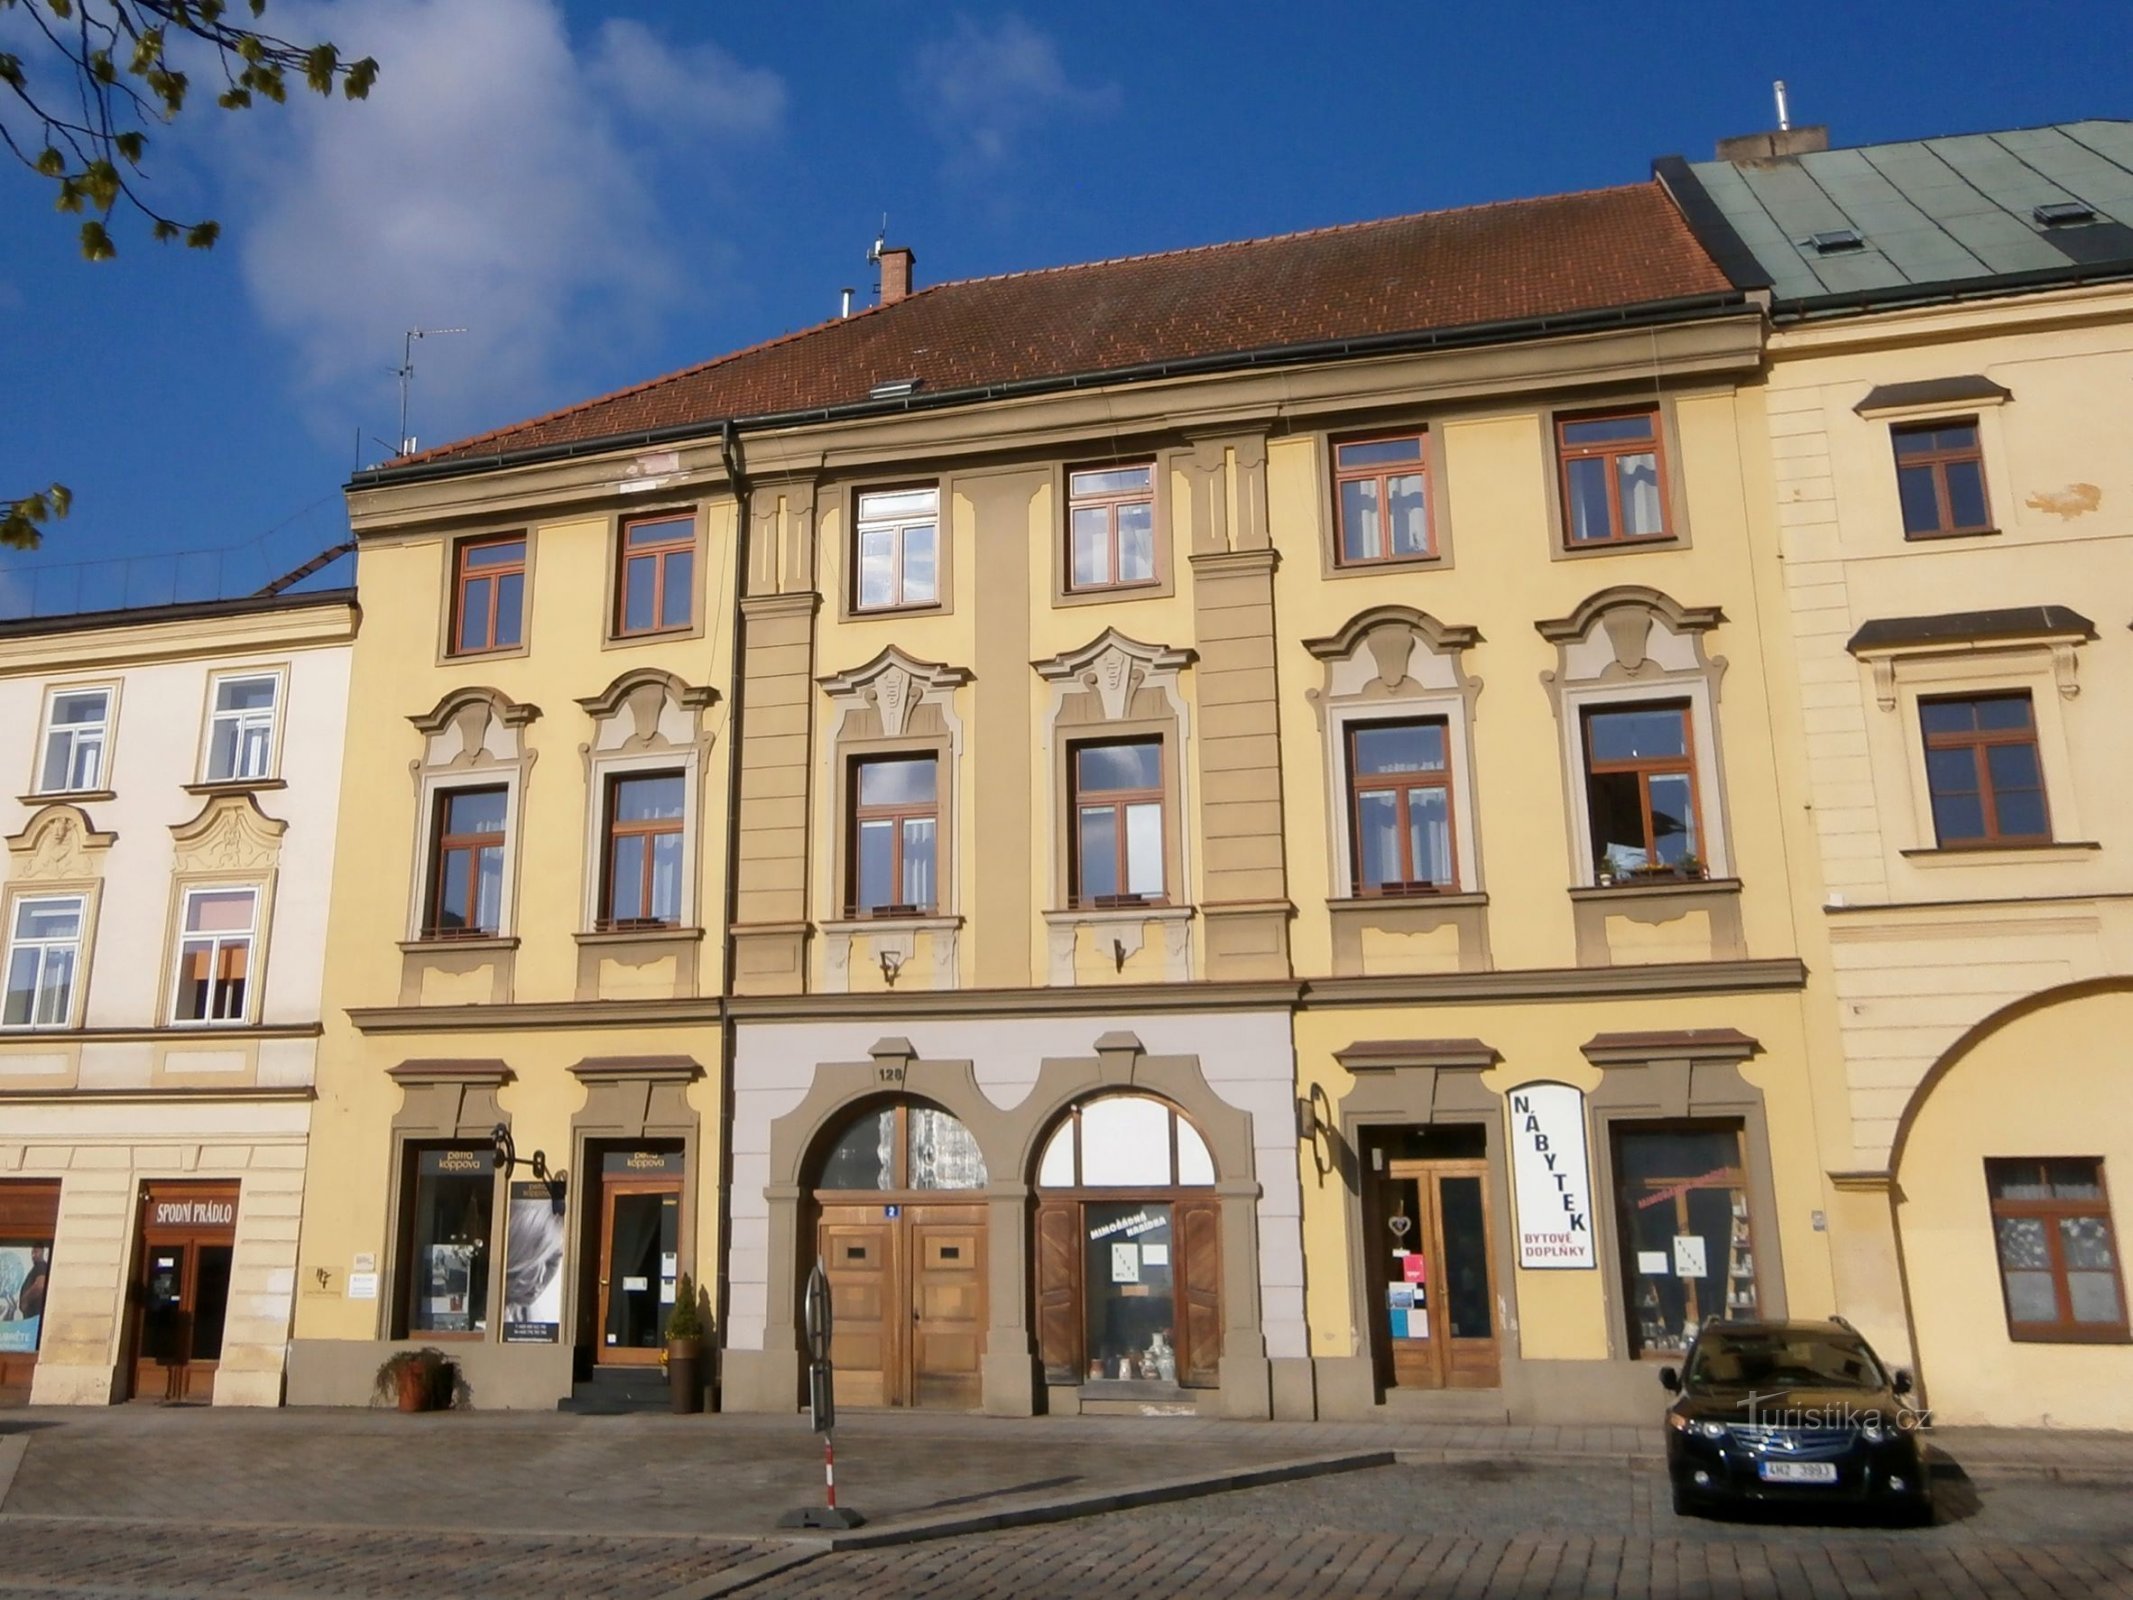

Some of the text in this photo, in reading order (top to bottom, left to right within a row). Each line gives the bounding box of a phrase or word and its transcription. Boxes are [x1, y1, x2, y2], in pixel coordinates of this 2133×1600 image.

[880, 1068, 903, 1082] 128
[1514, 1096, 1586, 1232] NÁBYTEK
[157, 1200, 232, 1224] SPODNÍ PRÁDLO
[888, 1206, 896, 1217] 2
[1524, 1231, 1573, 1244] BYTOVÉ
[1525, 1244, 1585, 1257] DOPLŇKY
